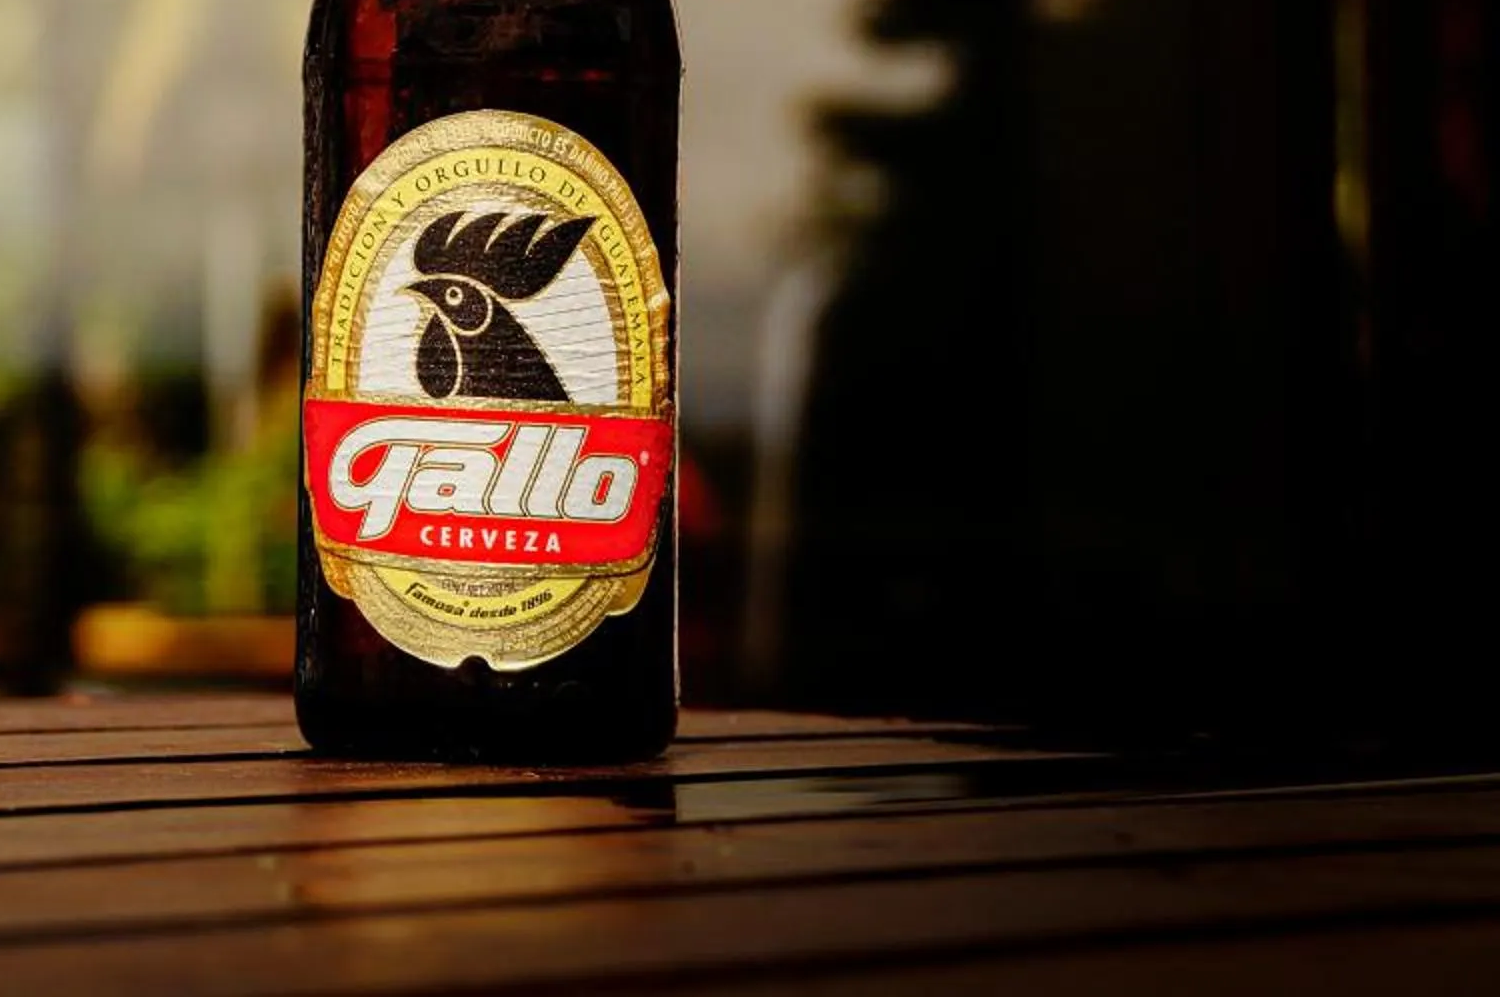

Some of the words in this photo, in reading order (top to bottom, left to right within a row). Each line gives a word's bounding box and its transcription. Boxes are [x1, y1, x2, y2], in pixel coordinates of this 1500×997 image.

[332, 210, 388, 367] TRADICION
[391, 191, 406, 209] Y
[415, 158, 547, 193] ORGULLO
[558, 180, 590, 210] DE
[599, 222, 647, 386] GUATEMALA
[419, 525, 562, 554] CERVEZA
[405, 582, 465, 616] Famosa
[469, 604, 517, 618] desde
[521, 589, 553, 611] 1896
